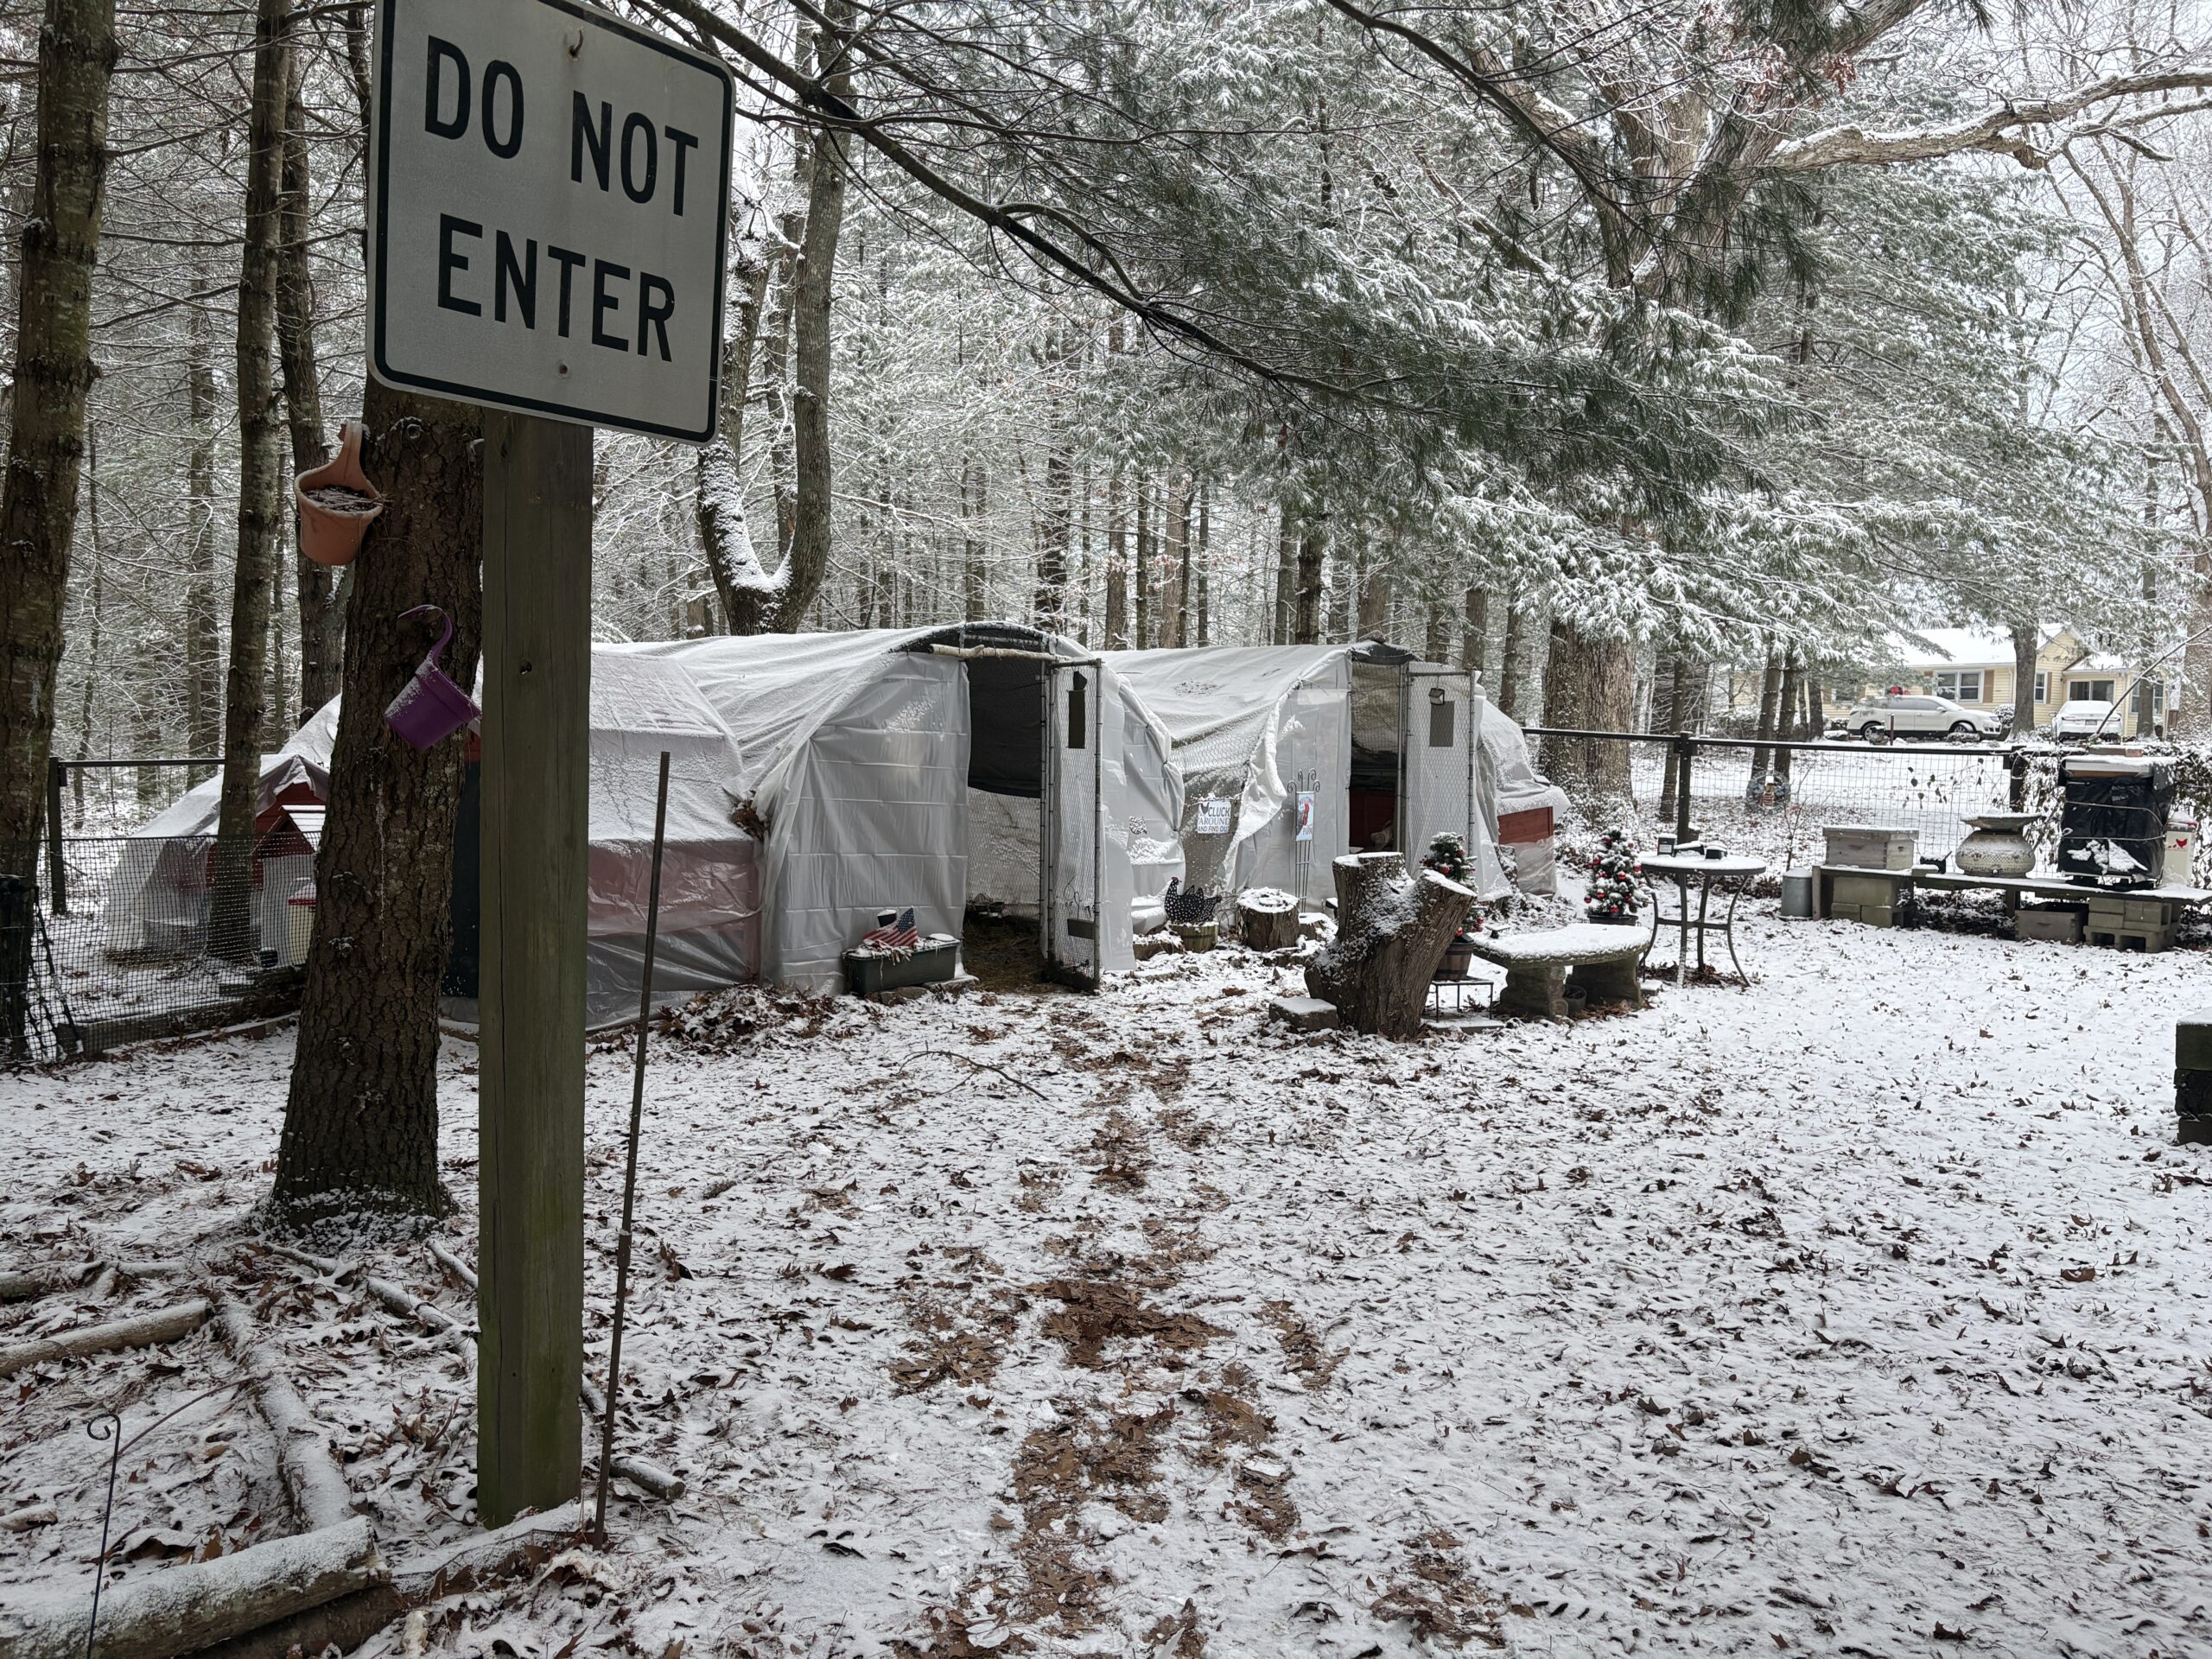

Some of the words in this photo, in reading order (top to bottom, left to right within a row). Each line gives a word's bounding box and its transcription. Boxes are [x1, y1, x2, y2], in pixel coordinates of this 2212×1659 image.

[424, 34, 524, 160] DO
[570, 90, 699, 217] NOT
[437, 212, 676, 363] ENTER
[1198, 817, 1230, 825] AROUND
[1208, 806, 1230, 817] CLUCK
